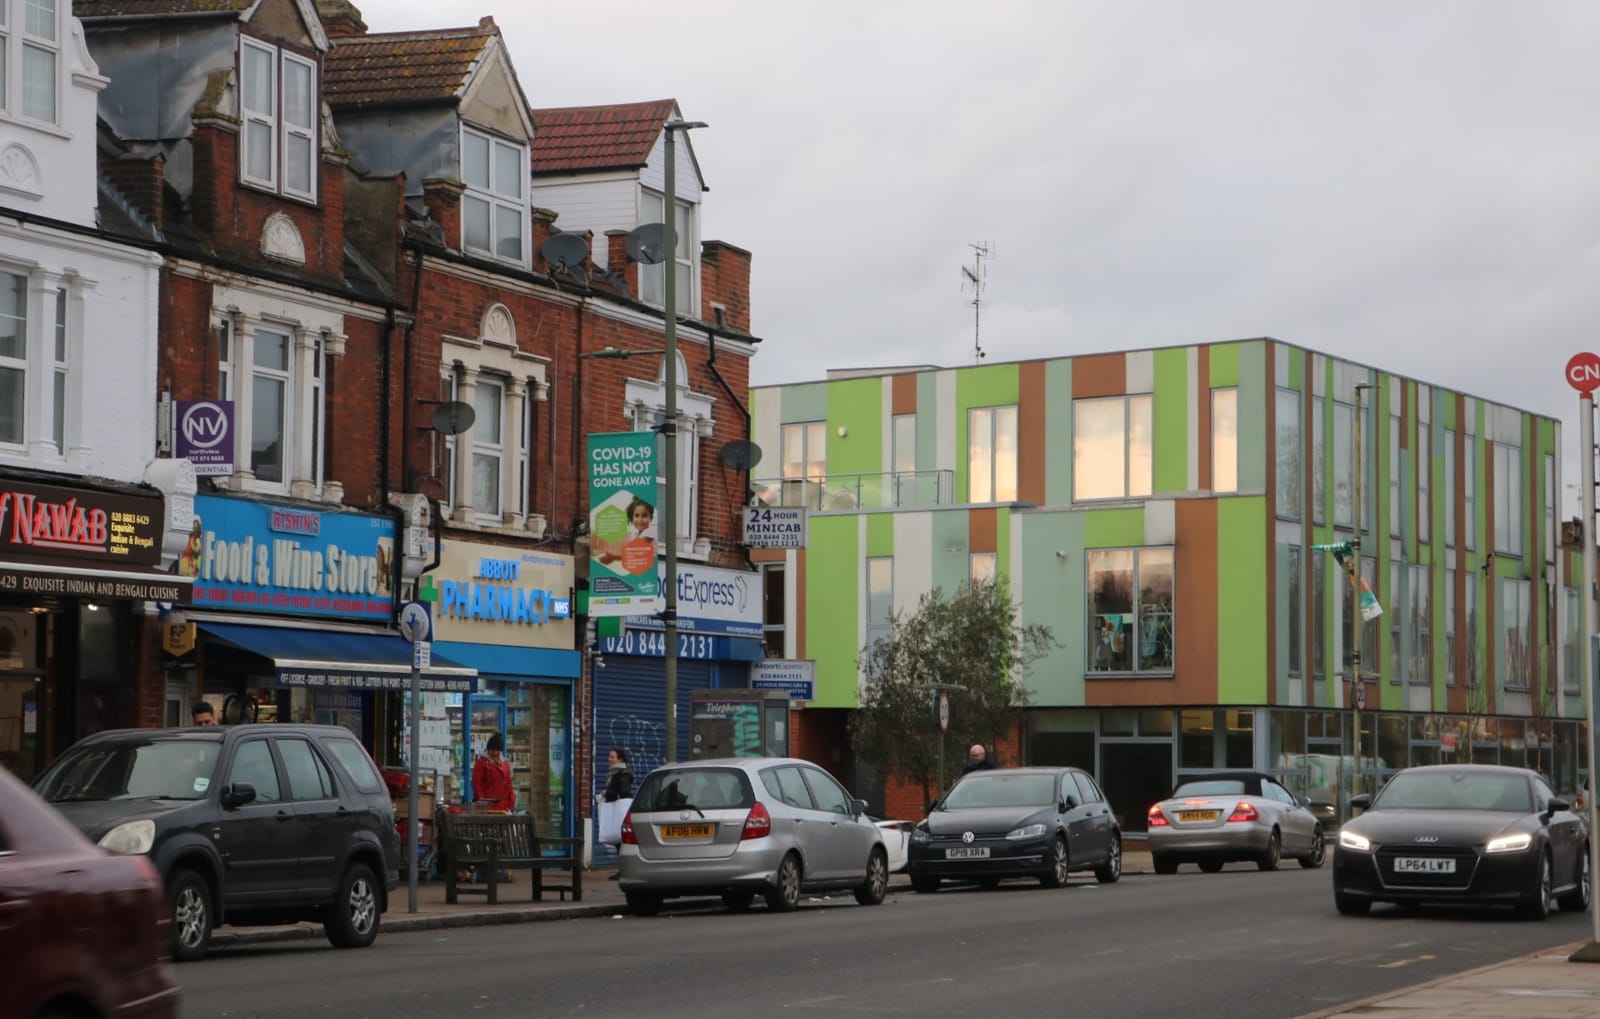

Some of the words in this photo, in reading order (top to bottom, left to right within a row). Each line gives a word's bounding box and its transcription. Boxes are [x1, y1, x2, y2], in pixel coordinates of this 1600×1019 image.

[187, 413, 223, 438] NV
[592, 446, 652, 461] COVID-19
[593, 462, 620, 476] HAS
[622, 461, 651, 475] NOT
[593, 478, 622, 488] GONE
[623, 476, 651, 485] AWAY
[10, 492, 107, 545] NAWAB
[750, 509, 772, 522] 24
[746, 523, 801, 533] MINICAB
[203, 531, 253, 584] Food
[256, 544, 270, 586] &
[273, 538, 323, 591] Wine
[326, 543, 377, 595] Store
[480, 558, 520, 580] ABBOTT
[23, 576, 65, 592] EXQUISITE
[66, 580, 95, 594] INDIAN
[97, 582, 113, 595] AND
[115, 583, 147, 597] BENGALI
[149, 586, 179, 600] CUISINE
[442, 580, 553, 624] PHARMACY
[554, 601, 569, 615] NHS
[639, 631, 666, 656] 844
[680, 634, 713, 659] 2131
[1399, 860, 1426, 870] LP64
[1429, 860, 1451, 871] LWT
